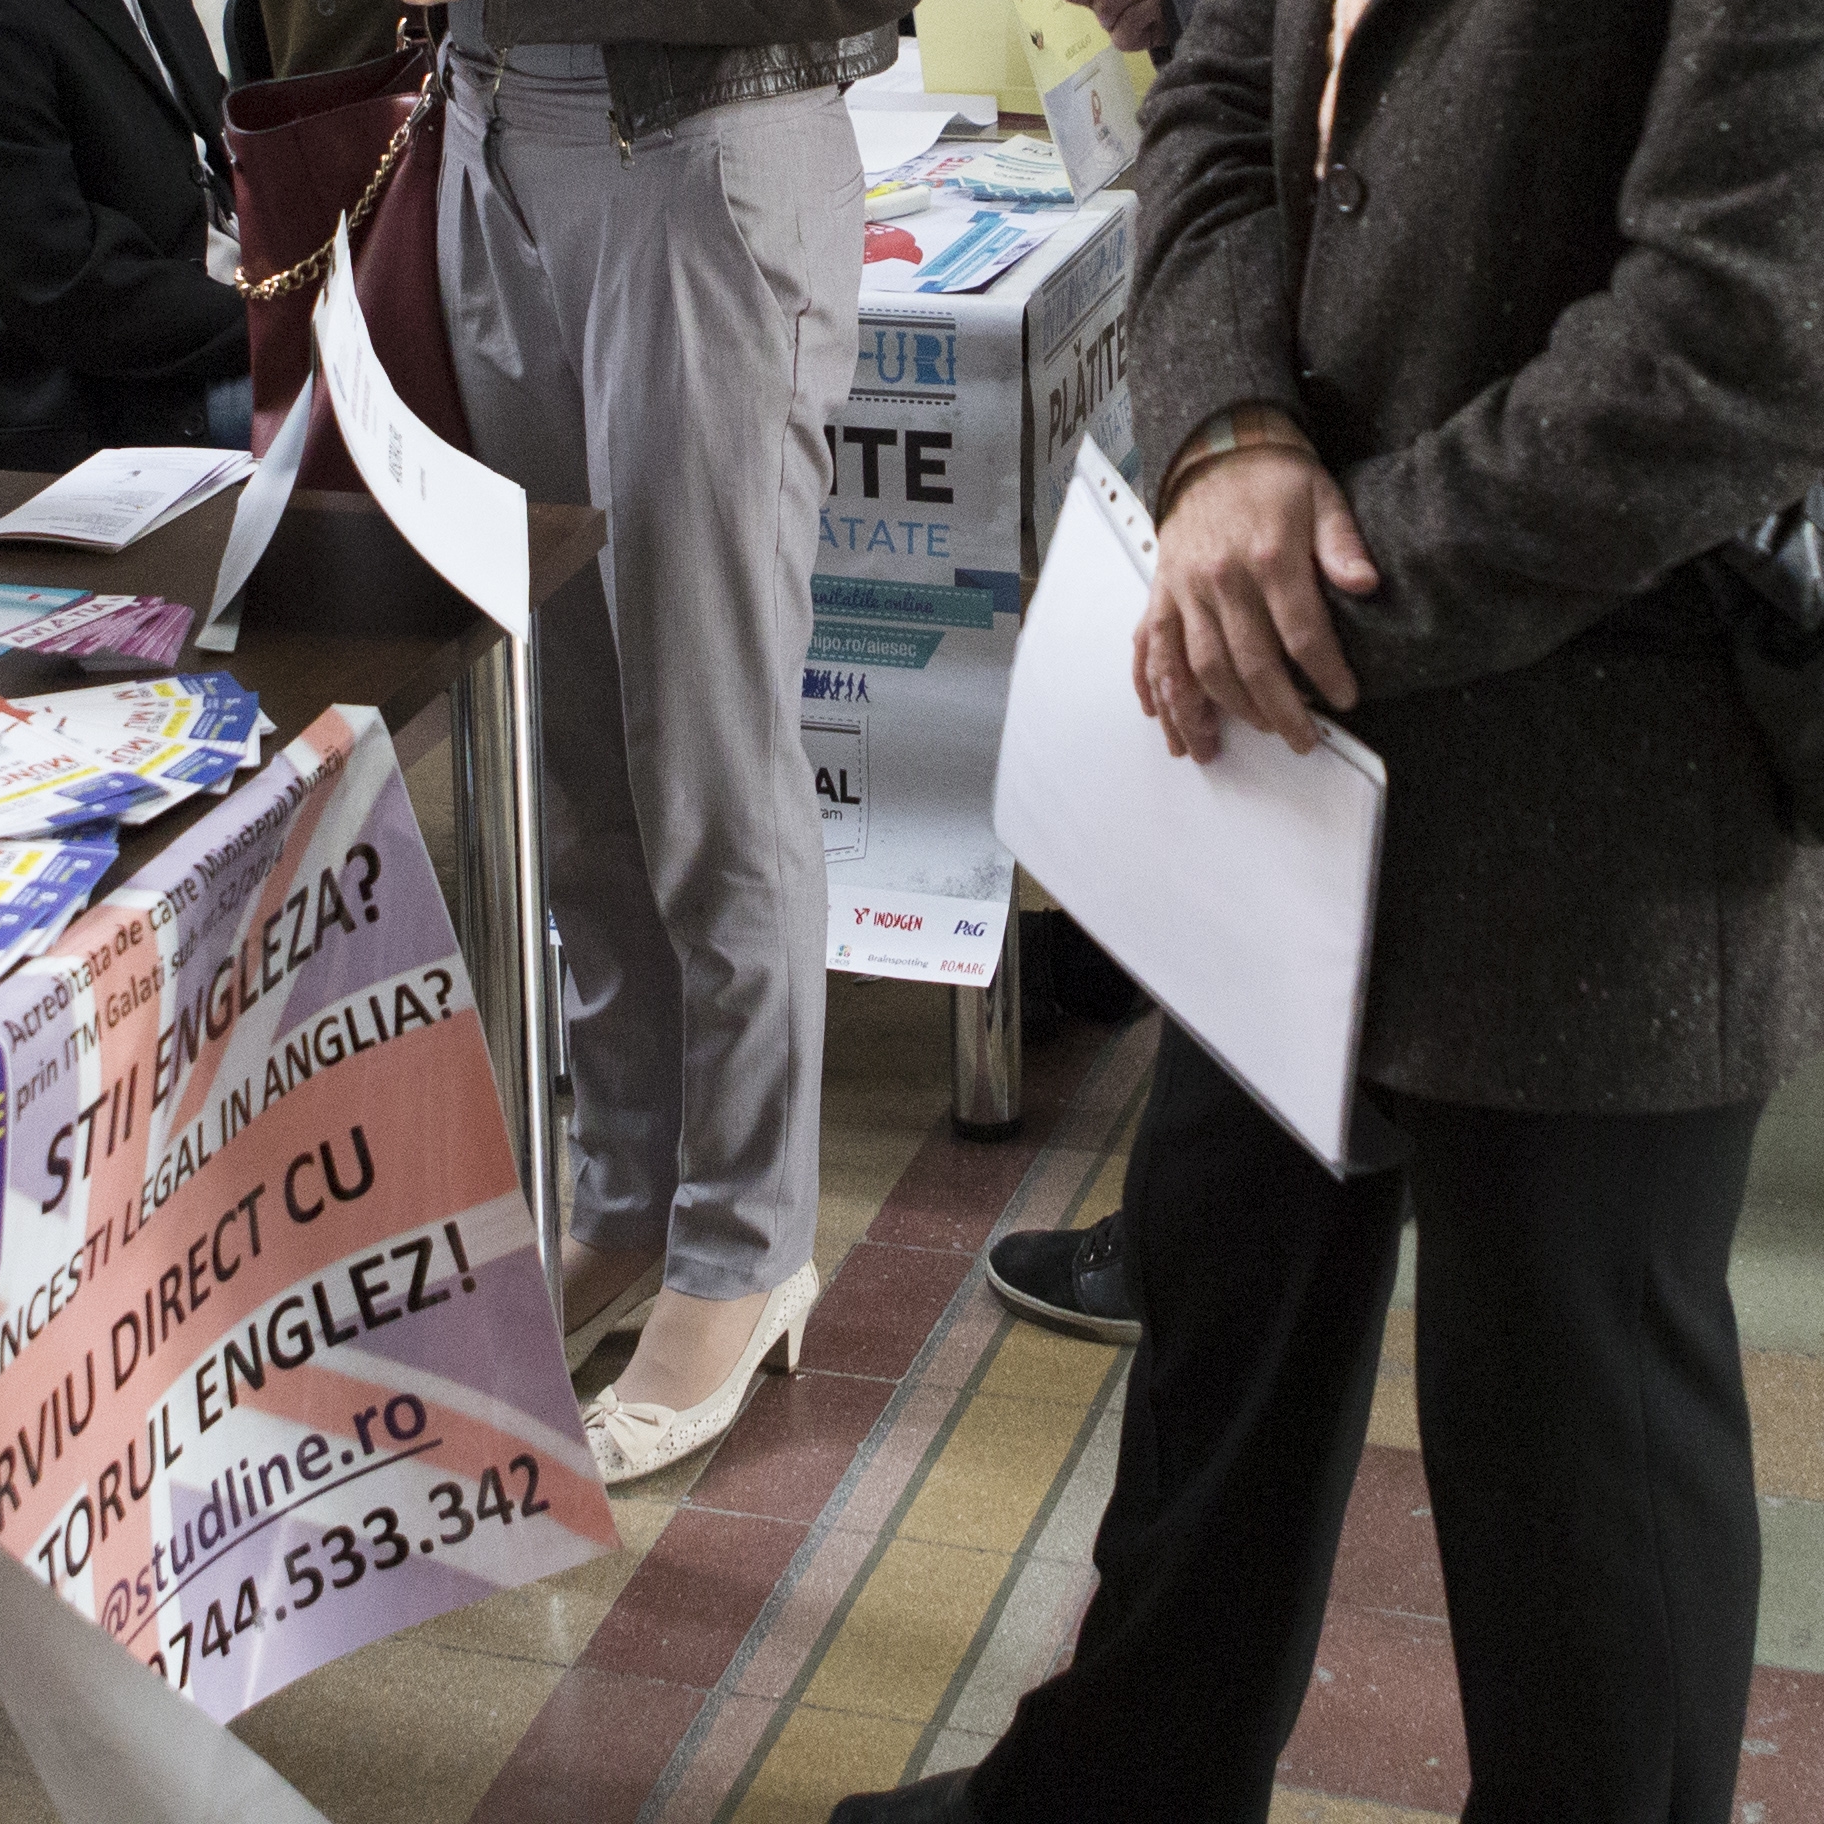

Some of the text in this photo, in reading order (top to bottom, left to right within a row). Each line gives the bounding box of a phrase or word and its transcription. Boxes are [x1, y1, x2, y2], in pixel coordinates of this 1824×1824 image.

[883, 592, 935, 614] online
[2, 941, 113, 1054] Acreditata
[111, 917, 144, 958] de
[147, 875, 199, 933] catre
[40, 1062, 140, 1216] STII
[151, 841, 384, 1113] ENGLEZA?
[873, 912, 988, 938] INDYGEN P&G
[939, 959, 987, 976] ROMARG
[14, 1054, 59, 1121] prin
[61, 1017, 105, 1072] ITM
[104, 955, 166, 1030] Galati
[121, 1131, 213, 1248] LEGAL
[219, 1074, 253, 1147] IN
[261, 966, 456, 1112] ANGLIA?
[110, 1182, 267, 1394] DIRECT
[283, 1124, 377, 1226] CU
[38, 1220, 477, 1589] TORUL ENGLEZ!
[101, 1392, 431, 1640] @studline.ro
